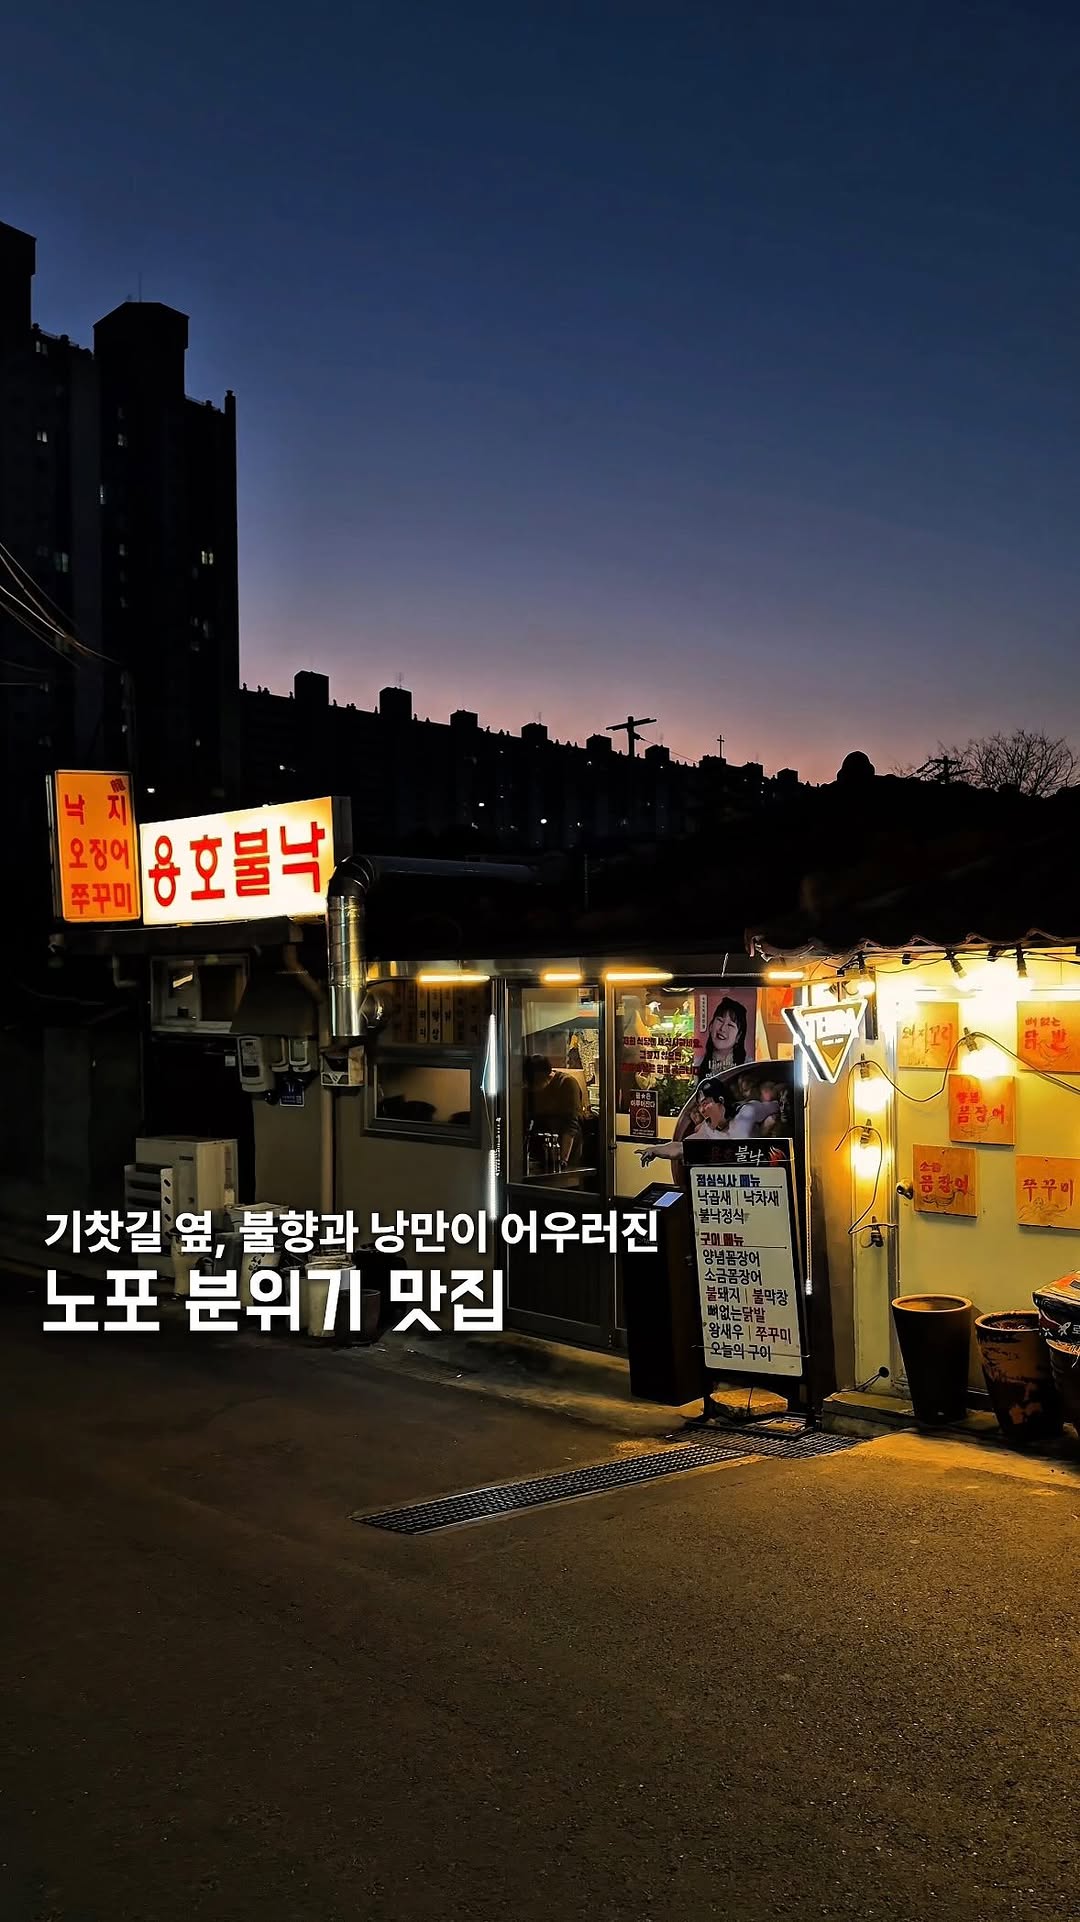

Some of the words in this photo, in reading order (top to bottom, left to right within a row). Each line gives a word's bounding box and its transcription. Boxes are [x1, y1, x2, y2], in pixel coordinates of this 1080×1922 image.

[69, 837, 129, 871] 오징어
[148, 821, 325, 907] 용호불낙
[71, 882, 131, 914] 쭈꾸미
[735, 1145, 764, 1166] 불낙
[698, 1190, 732, 1206] 낙곱새
[699, 1208, 745, 1225] 불낙정식
[702, 1249, 760, 1267] 양념꼼장어
[704, 1268, 763, 1286] 소금꼼장어
[705, 1286, 740, 1304] 불돼지
[752, 1288, 788, 1306] 불막창
[709, 1322, 744, 1340] 왕새우
[755, 1326, 792, 1345] 쭈꾸미
[710, 1341, 745, 1360] 오늘의
[748, 1345, 771, 1363] 구이
